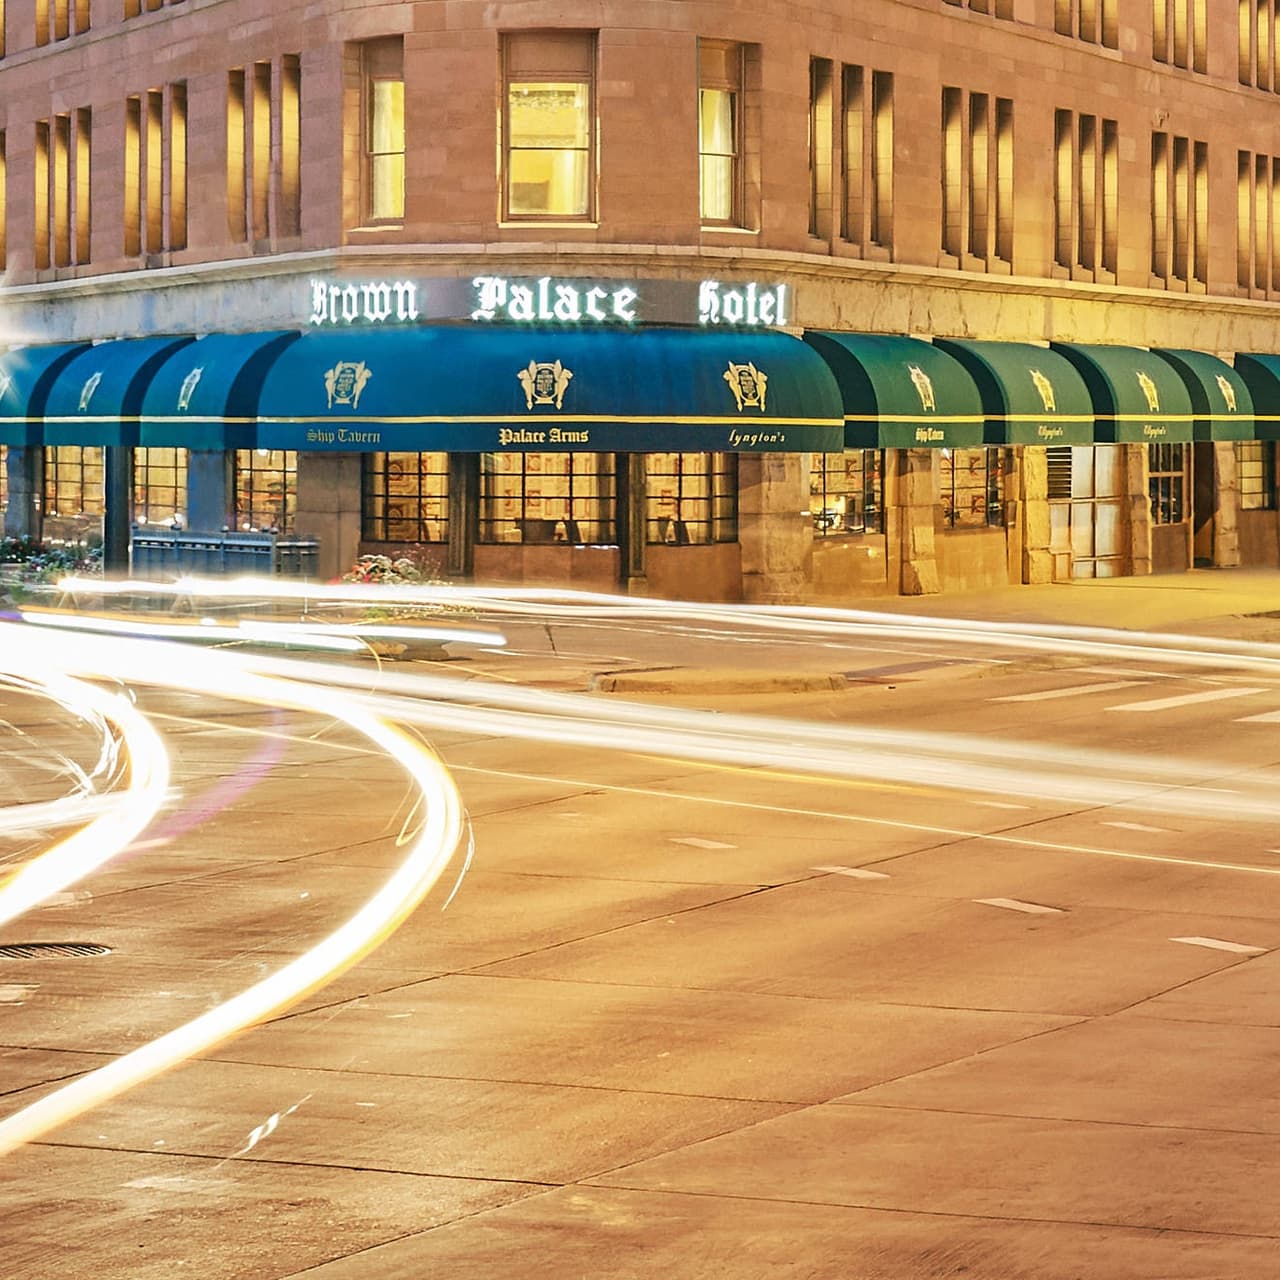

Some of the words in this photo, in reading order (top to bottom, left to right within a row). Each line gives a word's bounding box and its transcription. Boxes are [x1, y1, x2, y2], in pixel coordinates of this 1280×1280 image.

[310, 279, 419, 326] Brown
[471, 277, 637, 321] Palace
[699, 281, 787, 326] Hotel
[307, 429, 335, 444] Ship
[337, 428, 381, 443] Tavern
[499, 428, 546, 446] Palace
[549, 427, 589, 443] Arms
